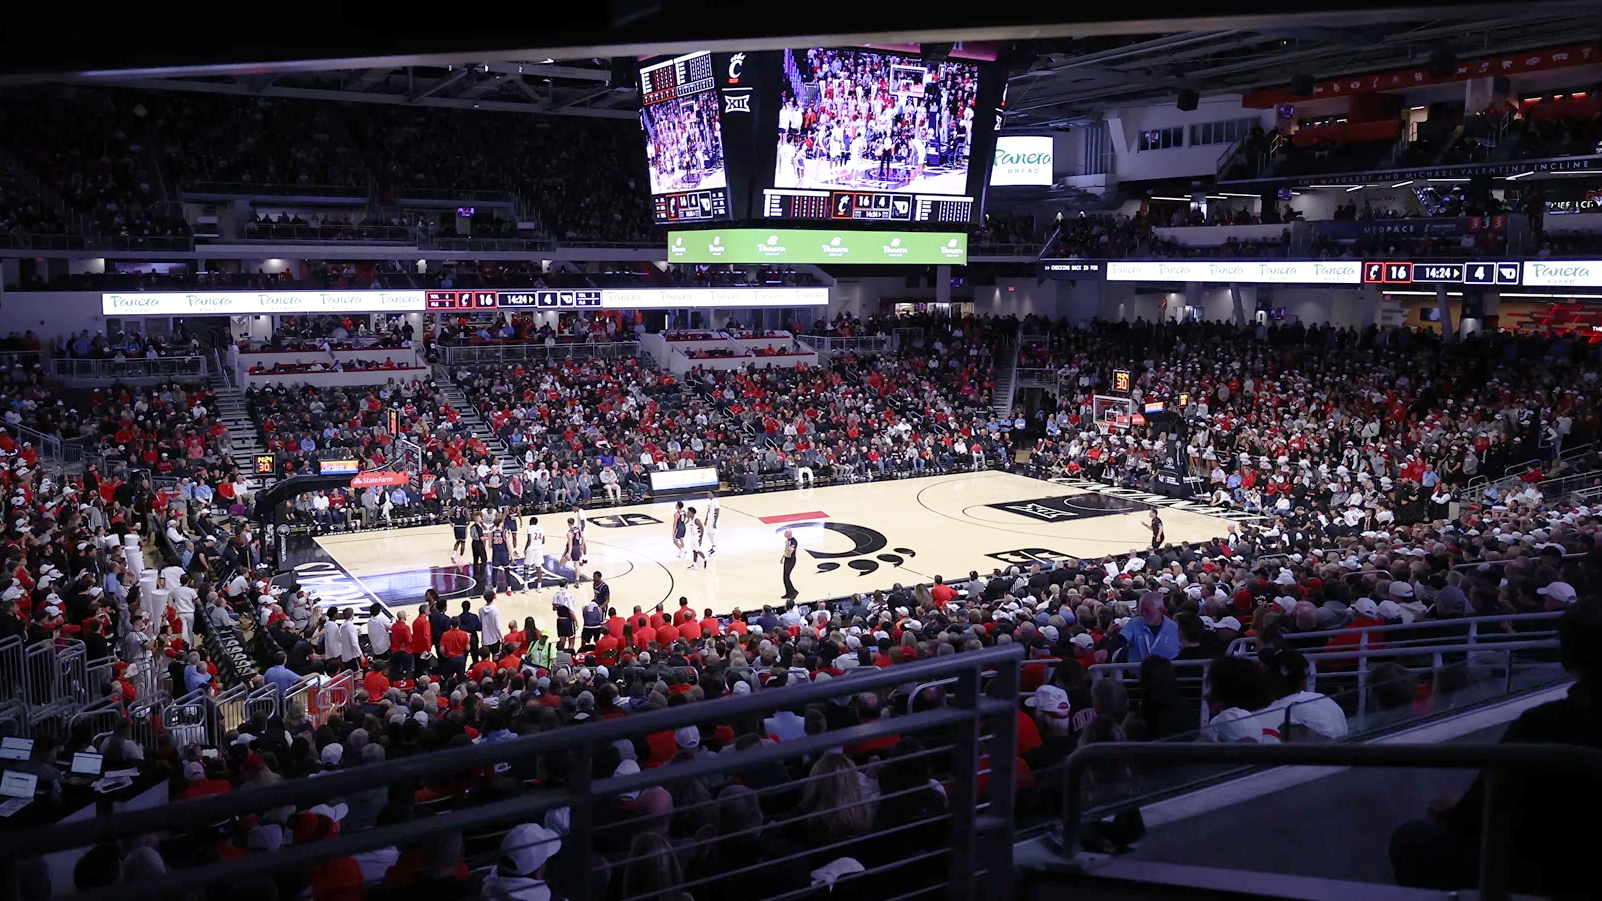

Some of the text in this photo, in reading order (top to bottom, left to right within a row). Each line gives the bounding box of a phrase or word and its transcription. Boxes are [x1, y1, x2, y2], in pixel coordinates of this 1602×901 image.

[993, 148, 1052, 166] Panera
[1405, 170, 1453, 178] MICHAEL
[1461, 164, 1526, 175] VALENTINE
[1534, 160, 1589, 170] INCLINE
[859, 196, 885, 206] 16 4
[1363, 225, 1414, 234] MEDPACE
[1390, 266, 1485, 279] 16 14:24 4
[1532, 263, 1589, 277] Panera
[110, 295, 159, 307] Panera
[186, 295, 232, 307] Panera
[479, 294, 552, 305] 16 14:24 4
[1116, 379, 1127, 390] 30
[259, 463, 269, 472] 30
[534, 532, 542, 541] 24
